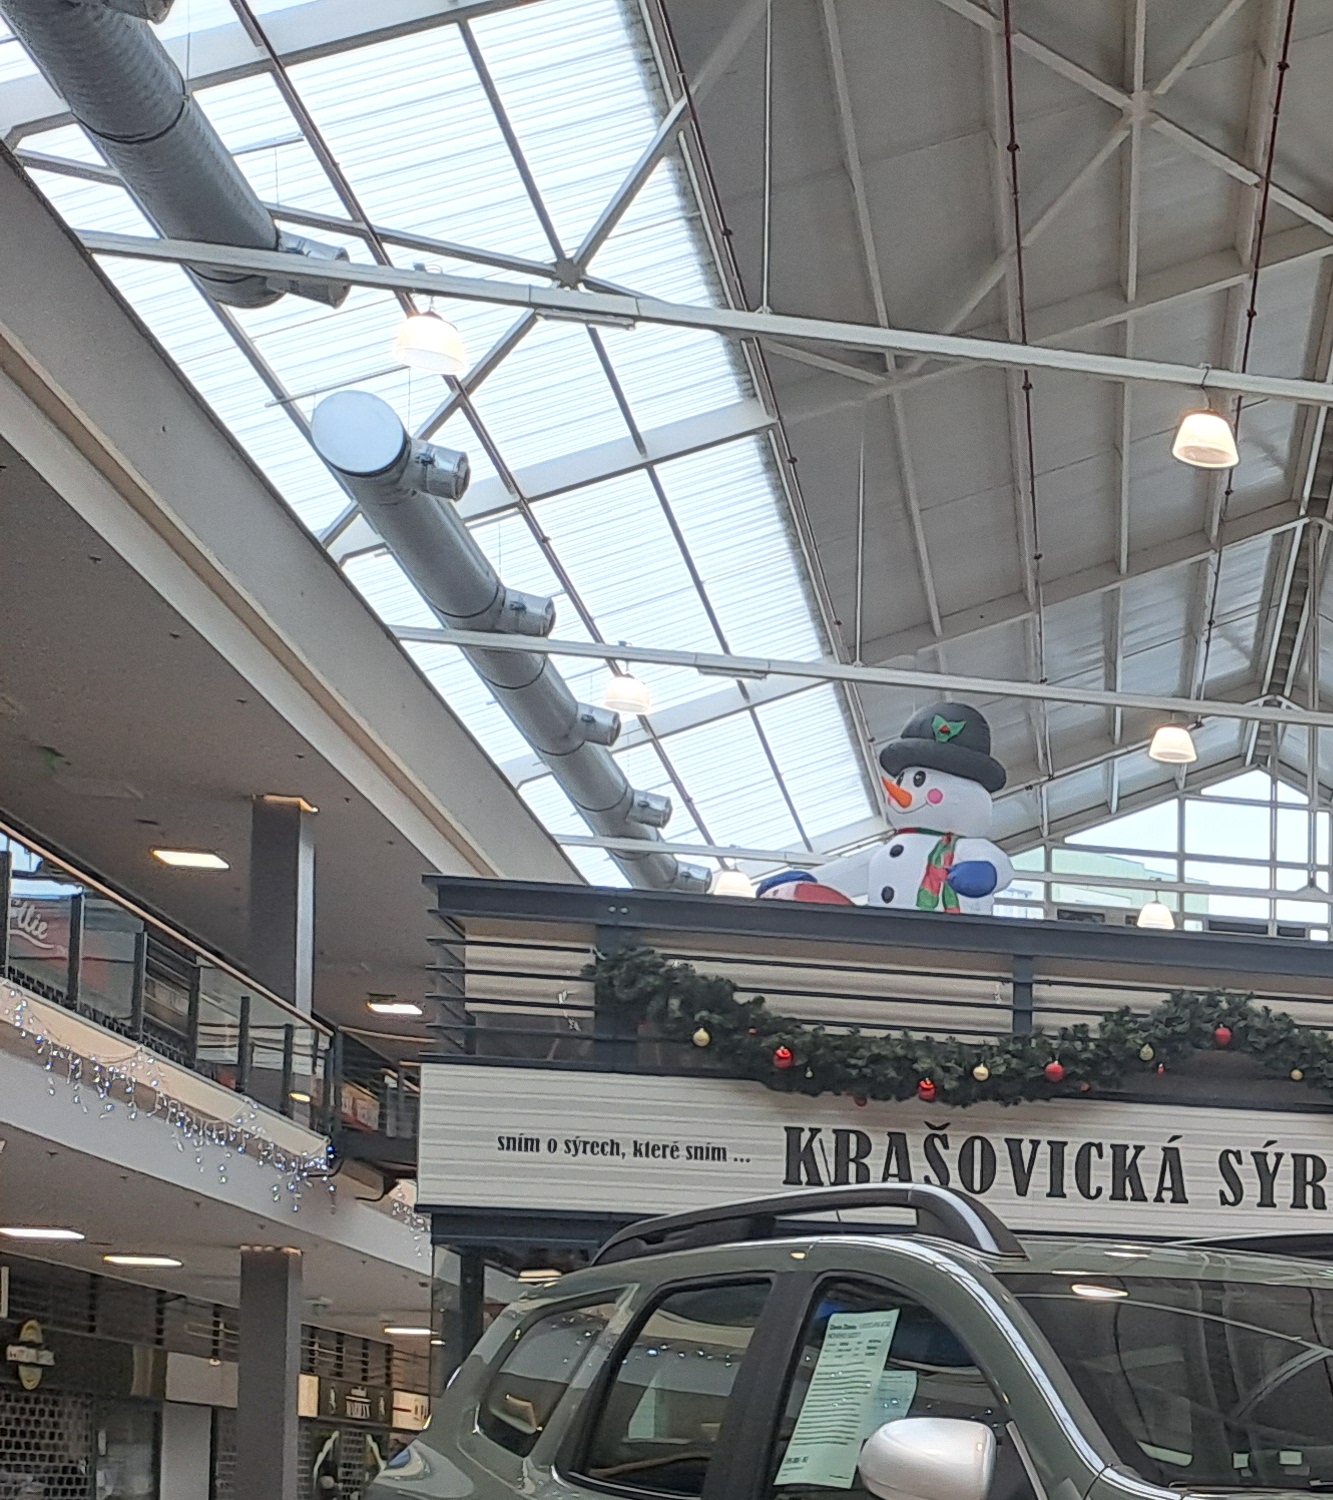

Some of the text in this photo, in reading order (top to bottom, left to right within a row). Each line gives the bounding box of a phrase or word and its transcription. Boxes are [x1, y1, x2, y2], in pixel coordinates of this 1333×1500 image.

[497, 1133, 540, 1153] sním
[547, 1138, 557, 1154] o
[564, 1135, 626, 1160] sýrech,
[632, 1140, 681, 1160] které
[685, 1142, 728, 1162] sním
[782, 1120, 1189, 1205] KRAŠOVICKÁ
